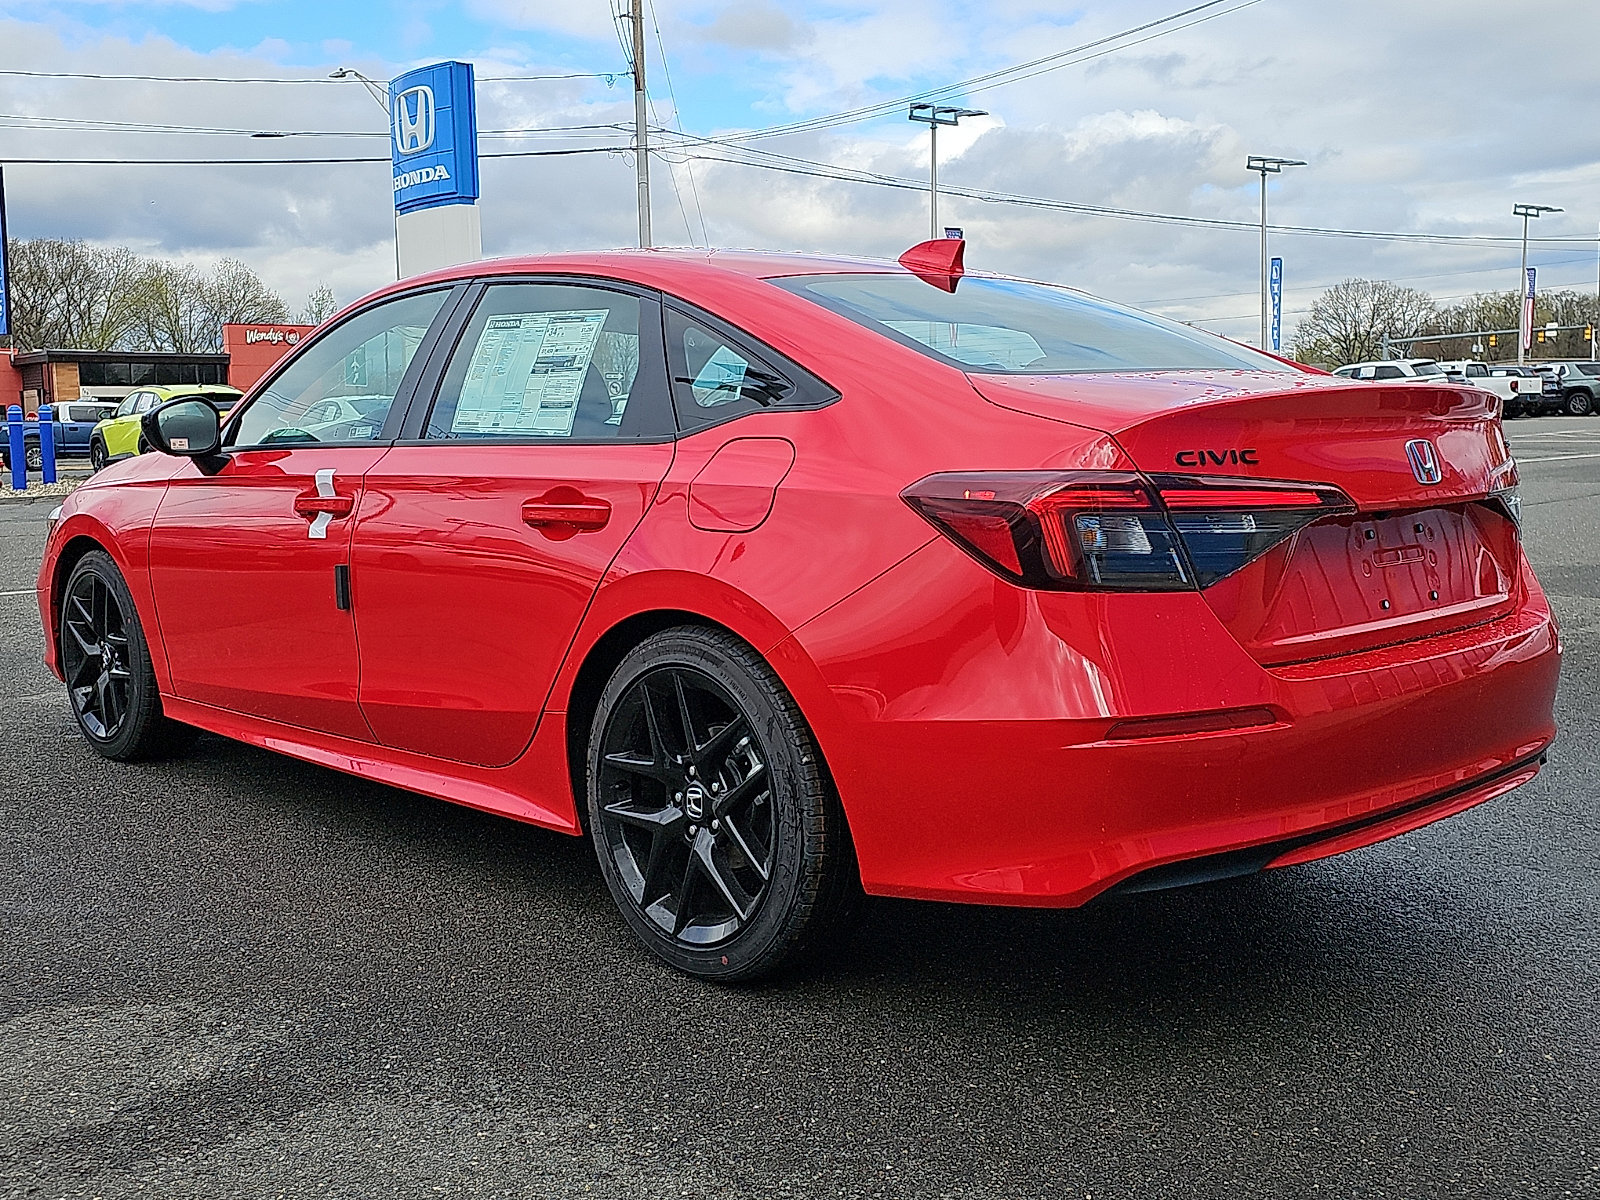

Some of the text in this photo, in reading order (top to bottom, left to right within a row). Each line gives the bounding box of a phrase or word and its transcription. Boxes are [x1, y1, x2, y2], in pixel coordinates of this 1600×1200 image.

[393, 164, 450, 192] HONDA
[494, 320, 520, 328] HONDA
[246, 327, 284, 345] Wendy's
[1175, 449, 1260, 467] CIVIC
